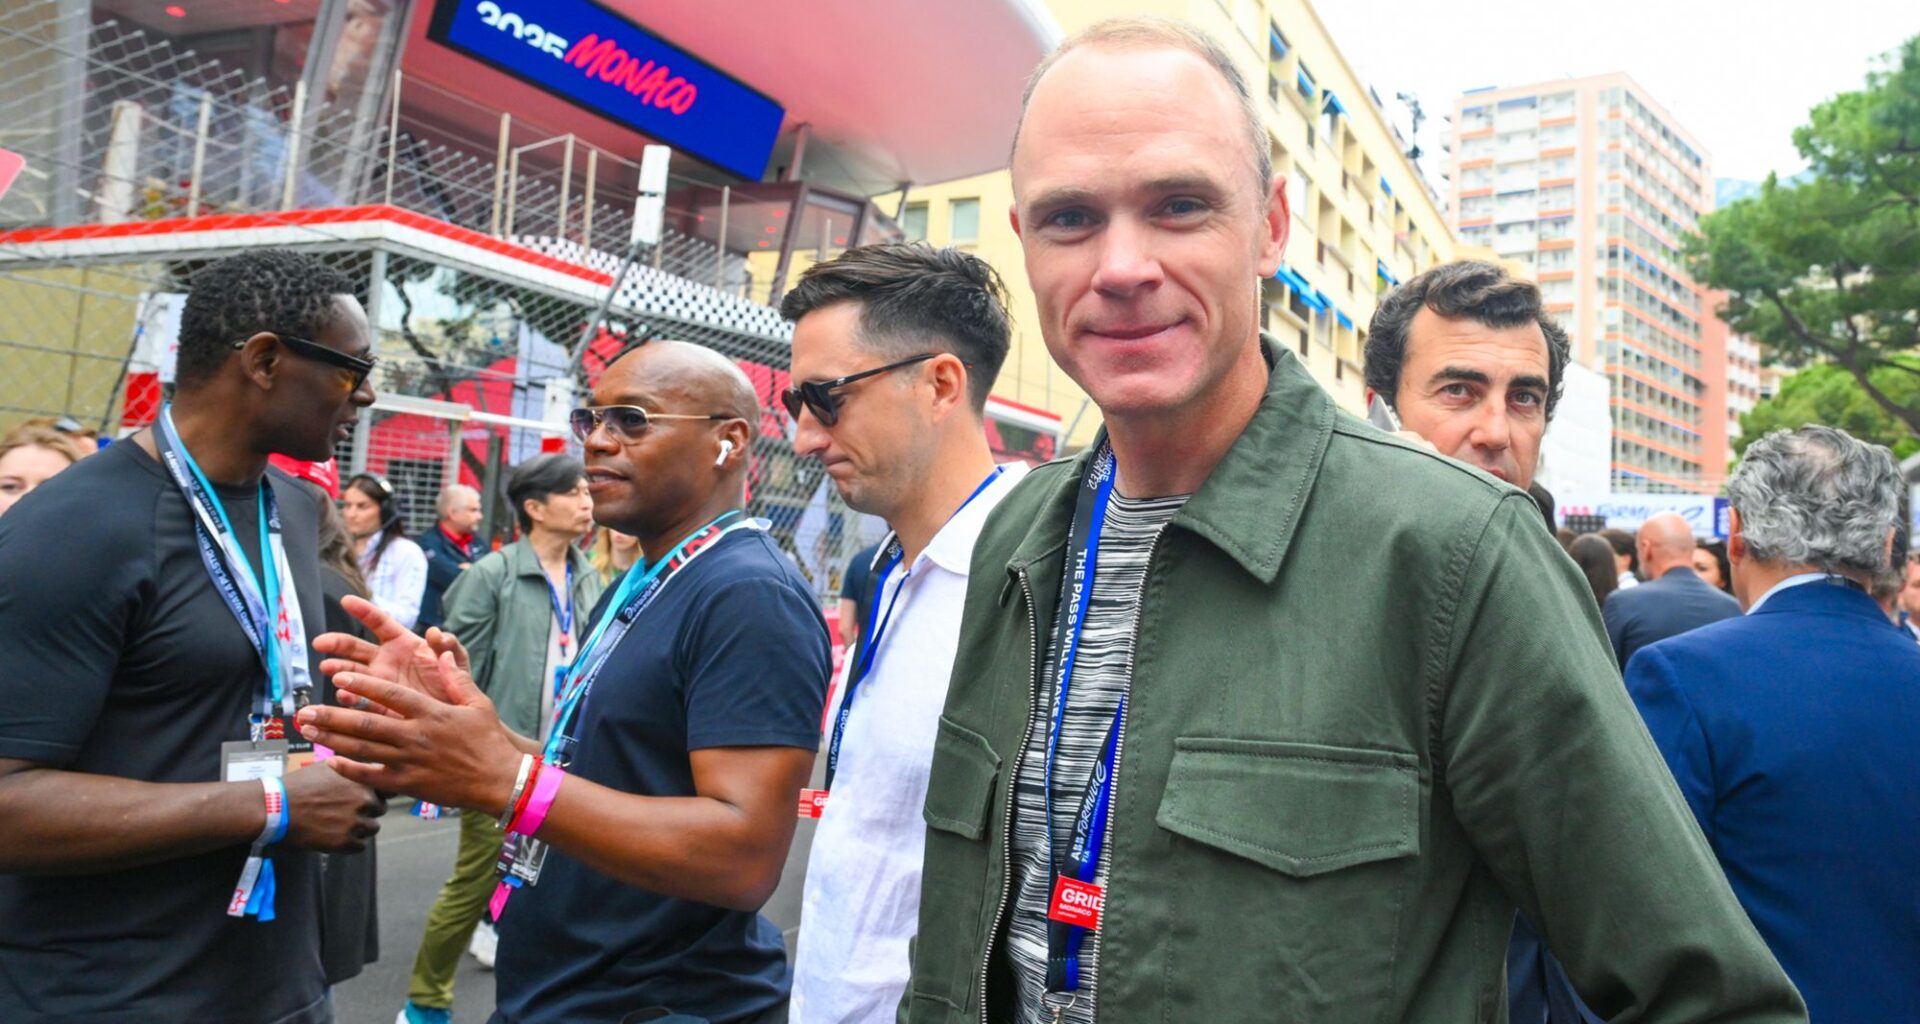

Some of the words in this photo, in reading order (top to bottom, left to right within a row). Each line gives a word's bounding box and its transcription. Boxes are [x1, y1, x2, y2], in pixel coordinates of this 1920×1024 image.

[563, 33, 697, 115] MONACO
[205, 549, 229, 585] PLASTIC
[1075, 549, 1088, 580] THE
[222, 582, 234, 592] A
[227, 589, 244, 612] WAS
[1068, 584, 1083, 625] PASS
[1060, 626, 1075, 666] WILL
[1052, 669, 1065, 718] MAKE
[1049, 722, 1056, 733] A
[1070, 835, 1084, 860] ABB
[1077, 780, 1099, 836] FORMULA
[1096, 760, 1107, 783] E
[1081, 849, 1090, 863] FIA
[1059, 902, 1092, 916] MONACO
